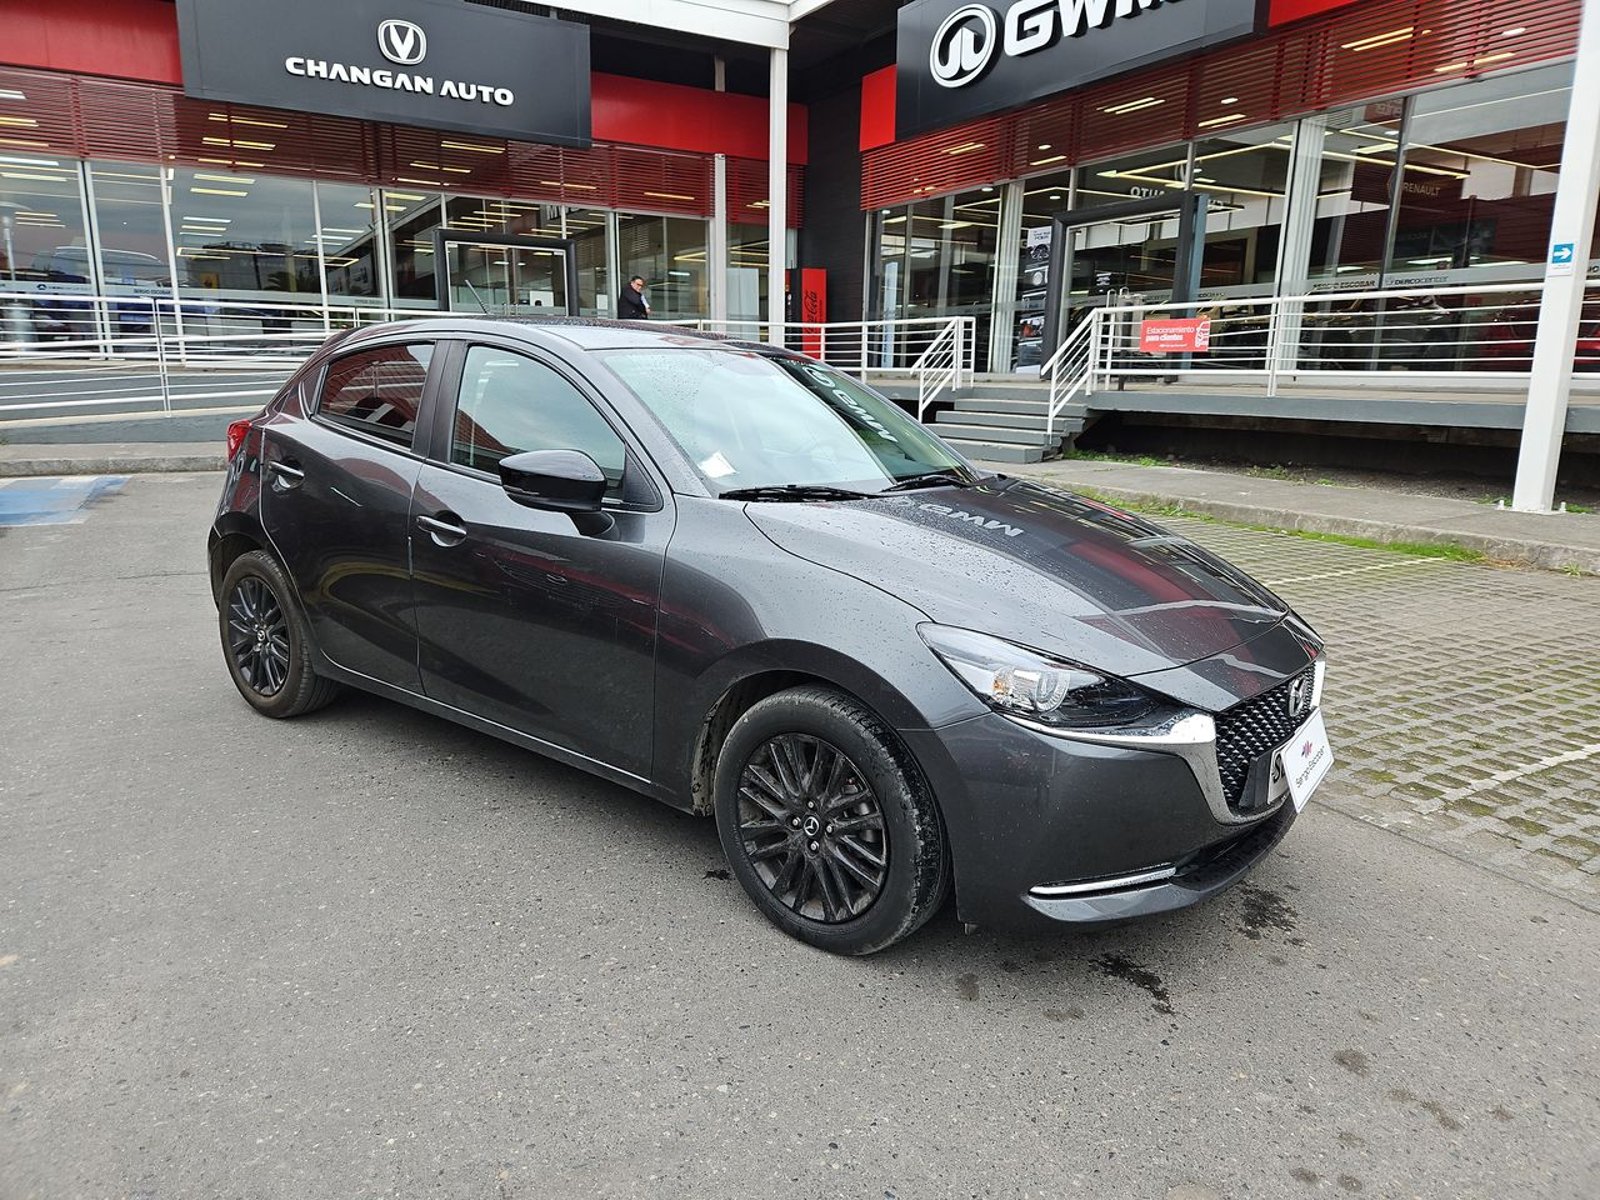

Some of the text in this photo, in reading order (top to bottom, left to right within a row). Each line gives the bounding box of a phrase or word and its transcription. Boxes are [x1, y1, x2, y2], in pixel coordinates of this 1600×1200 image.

[285, 57, 515, 106] CHANGAN AUTO
[1403, 182, 1441, 196] RENAULT
